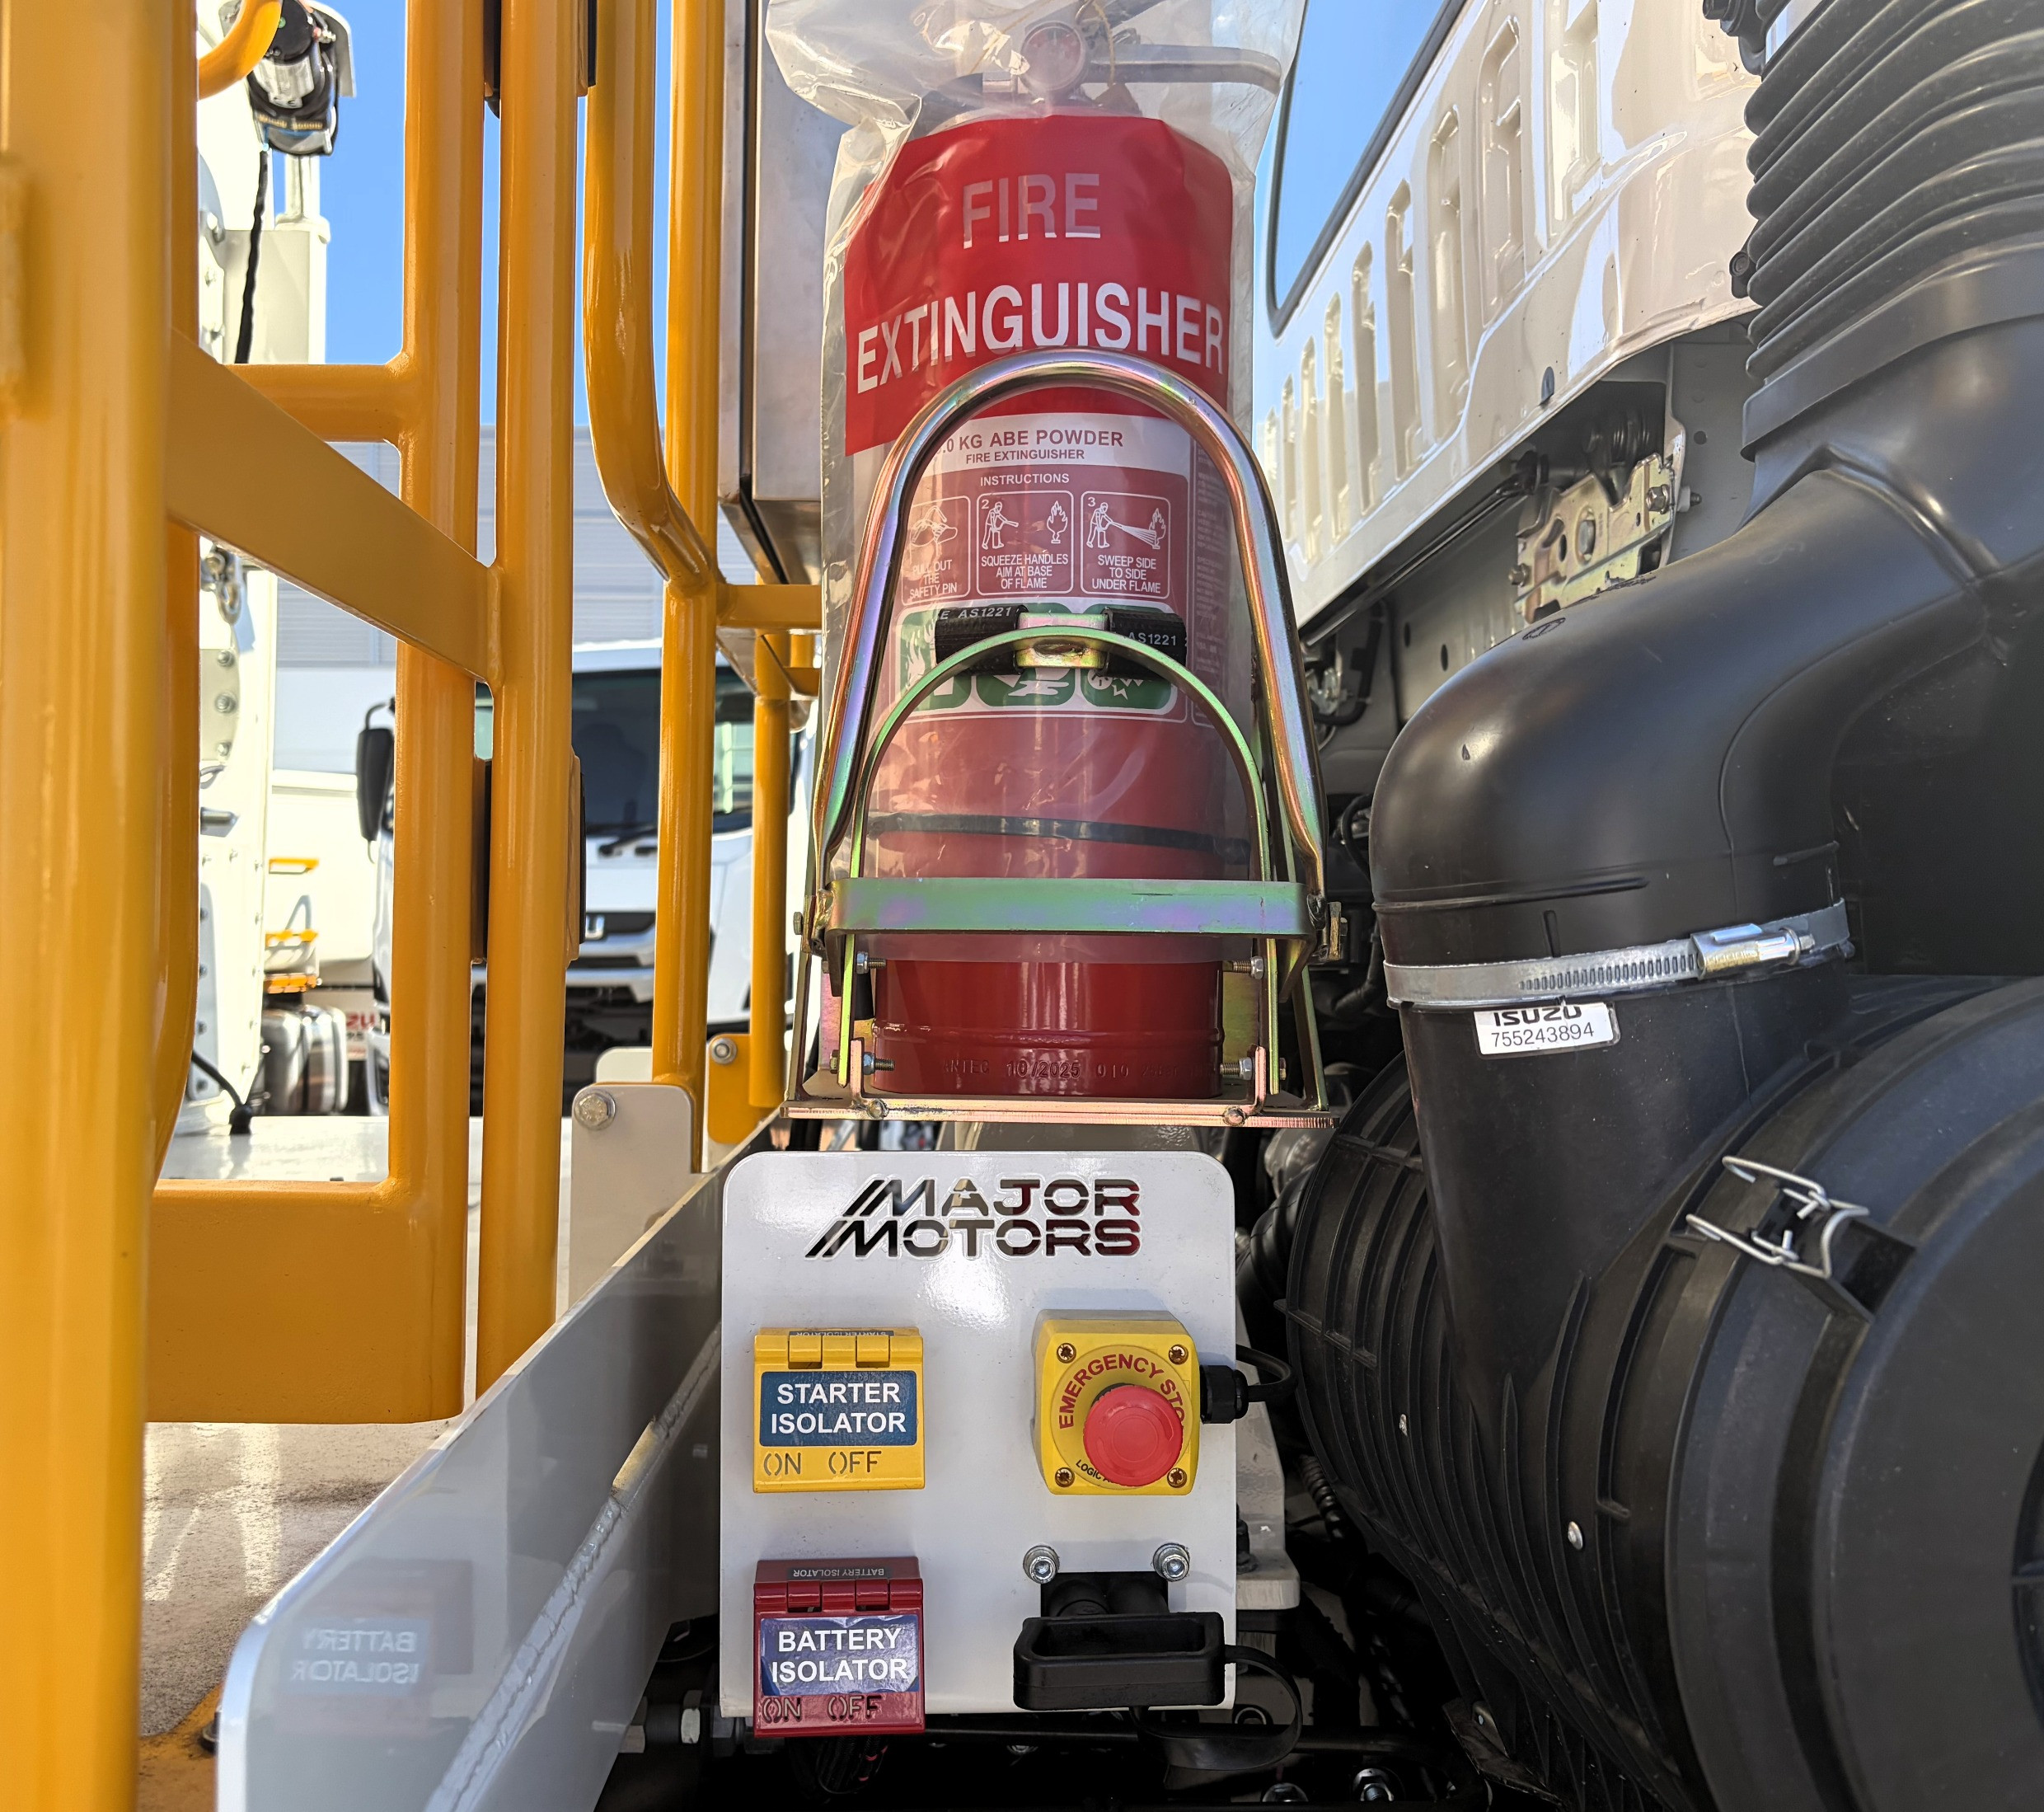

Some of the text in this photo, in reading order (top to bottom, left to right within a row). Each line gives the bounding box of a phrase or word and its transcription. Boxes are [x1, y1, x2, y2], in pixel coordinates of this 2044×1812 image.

[963, 173, 1101, 249] FIRE
[856, 282, 1224, 394] EXTINGUISHER
[959, 434, 982, 450] KG
[989, 430, 1029, 448] ABE
[1036, 429, 1123, 448] POWDER
[965, 449, 1085, 464] FIRE EXTINGUISHER
[980, 472, 1070, 487] INSTRUCTIONS
[981, 499, 989, 509] 2
[1087, 497, 1096, 508] 3
[912, 559, 952, 575] PULL OUT
[981, 553, 1068, 567] SQUEEZE HANDLES
[1098, 554, 1156, 570] SWEEP SIDE
[923, 573, 940, 585] THE
[996, 566, 1052, 578] AIM AT BASE
[1109, 567, 1146, 580] TO SIDE
[909, 582, 957, 599] SAFETY PIN
[1001, 577, 1047, 590] OF FLAME
[1092, 578, 1160, 594] UNDER FLAME
[958, 606, 1011, 619] AS1221
[1128, 631, 1176, 646] AS1221
[1493, 1006, 1582, 1027] ISUZU
[1491, 1021, 1594, 1048] 755243894
[1006, 1059, 1081, 1078] 10/2025
[842, 1179, 1141, 1217] MAJOR
[804, 1219, 1141, 1258] MOTORS
[776, 1382, 901, 1404] STARTER
[1058, 1354, 1185, 1429] EMERGENCY STO
[771, 1412, 907, 1434] ISOLATOR
[763, 1450, 882, 1476] ON OFF
[1076, 1459, 1103, 1481] LOGIC
[793, 1568, 884, 1577] BATTERY ISOLATOR
[778, 1627, 902, 1652] BATTERY
[771, 1658, 907, 1683] ISOLATOR
[763, 1695, 882, 1723] ON OFF
